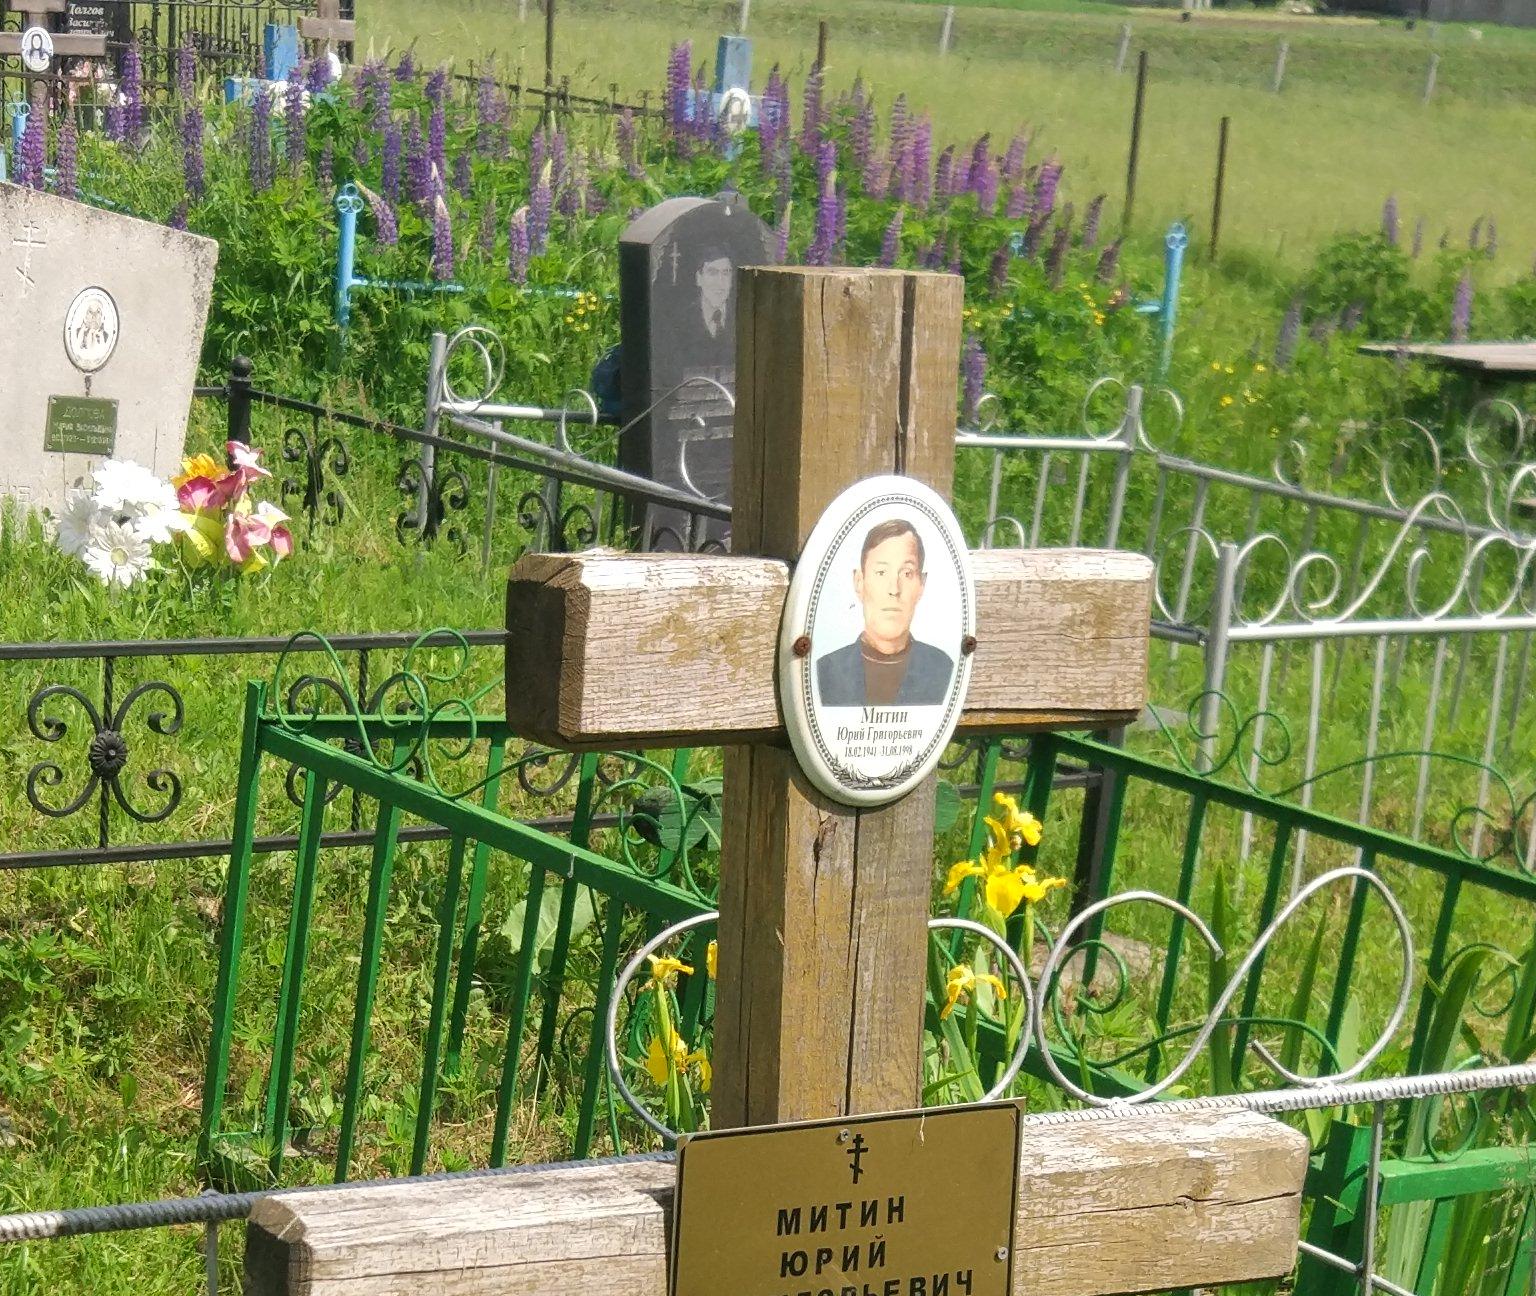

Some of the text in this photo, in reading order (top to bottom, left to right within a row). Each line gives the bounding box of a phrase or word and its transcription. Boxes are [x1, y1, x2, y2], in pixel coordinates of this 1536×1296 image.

[861, 707, 908, 723] Митин
[837, 727, 865, 744] Юрий
[777, 1196, 904, 1236] МИТИН
[779, 1234, 886, 1278] ЮРИЙ
